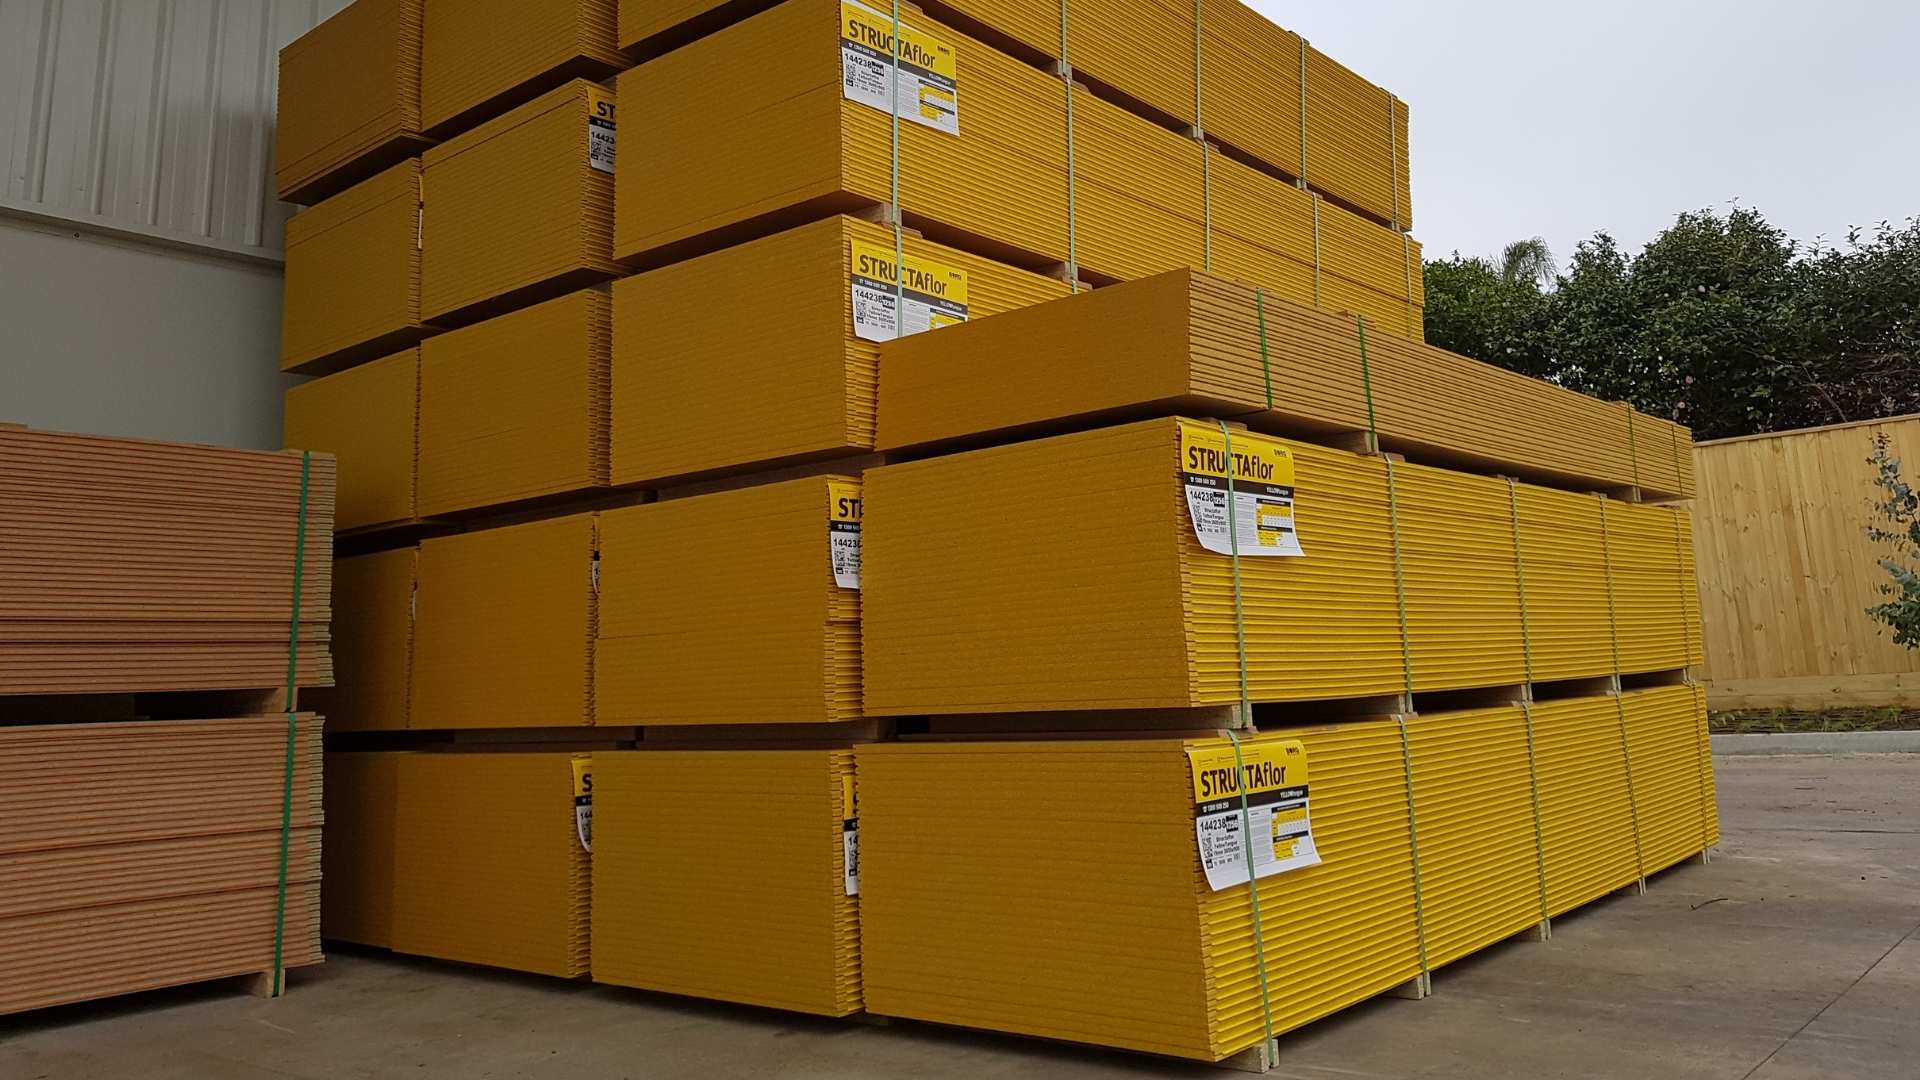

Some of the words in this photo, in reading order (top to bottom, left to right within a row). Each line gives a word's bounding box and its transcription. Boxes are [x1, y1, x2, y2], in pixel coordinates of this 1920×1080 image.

[848, 20, 936, 68] STRUCTAflor
[845, 53, 872, 69] 144238
[591, 131, 615, 144] 14423
[855, 289, 883, 304] 144238
[1189, 490, 1214, 503] 144238
[833, 538, 860, 548] 14423
[1200, 761, 1287, 797] STRUCTAflor
[1200, 818, 1226, 833] 144238
